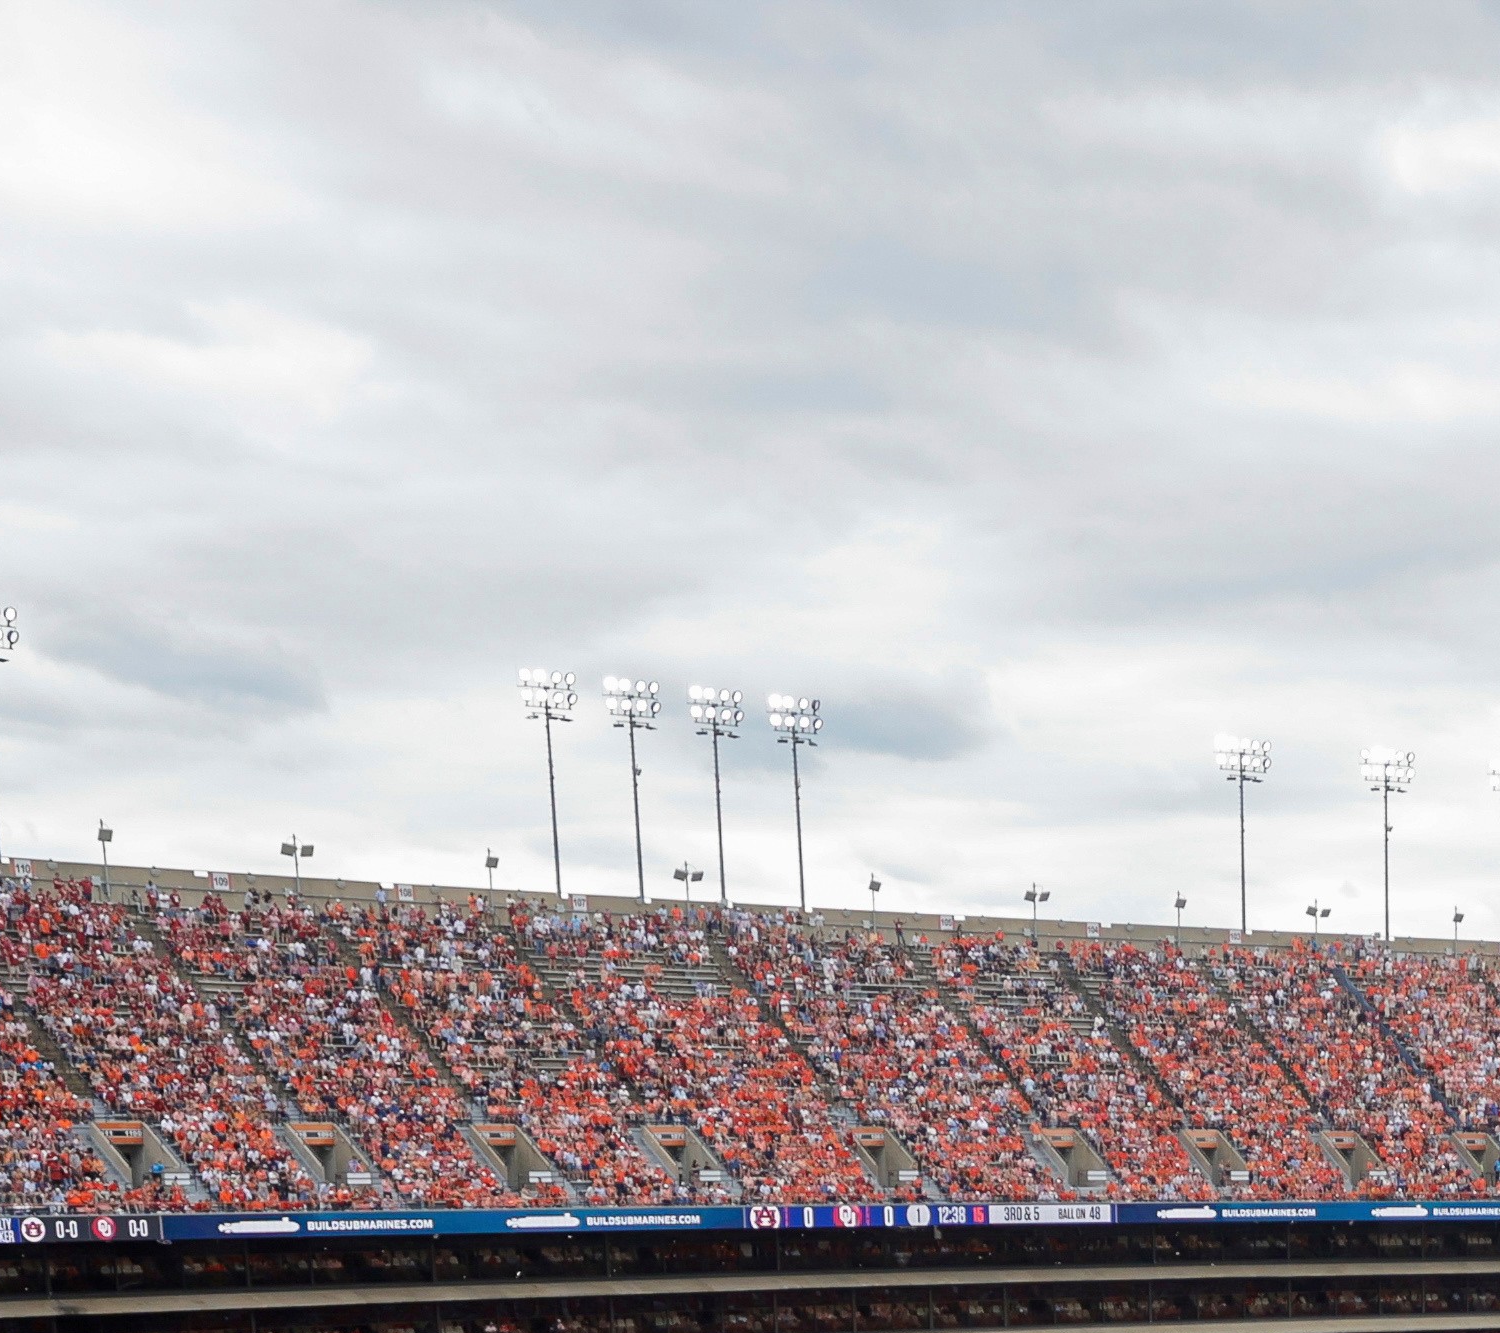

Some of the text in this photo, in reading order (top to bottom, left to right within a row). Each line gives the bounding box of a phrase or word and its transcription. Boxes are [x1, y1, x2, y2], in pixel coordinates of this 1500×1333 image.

[586, 1214, 700, 1226] BUILDSUBMARINES.COM
[804, 1206, 814, 1227] 0
[885, 1206, 895, 1226] 0
[938, 1206, 966, 1223] 12:38
[1004, 1207, 1021, 1221] 3RD
[1034, 1206, 1040, 1221] 5
[1059, 1206, 1101, 1220] BALL ON 48
[1222, 1208, 1316, 1218] BUILDSUBMARINES.COM
[56, 1221, 78, 1238] 0-0
[129, 1219, 148, 1237] 0-0
[307, 1218, 433, 1231] BUILDSUBMARINES.COM
